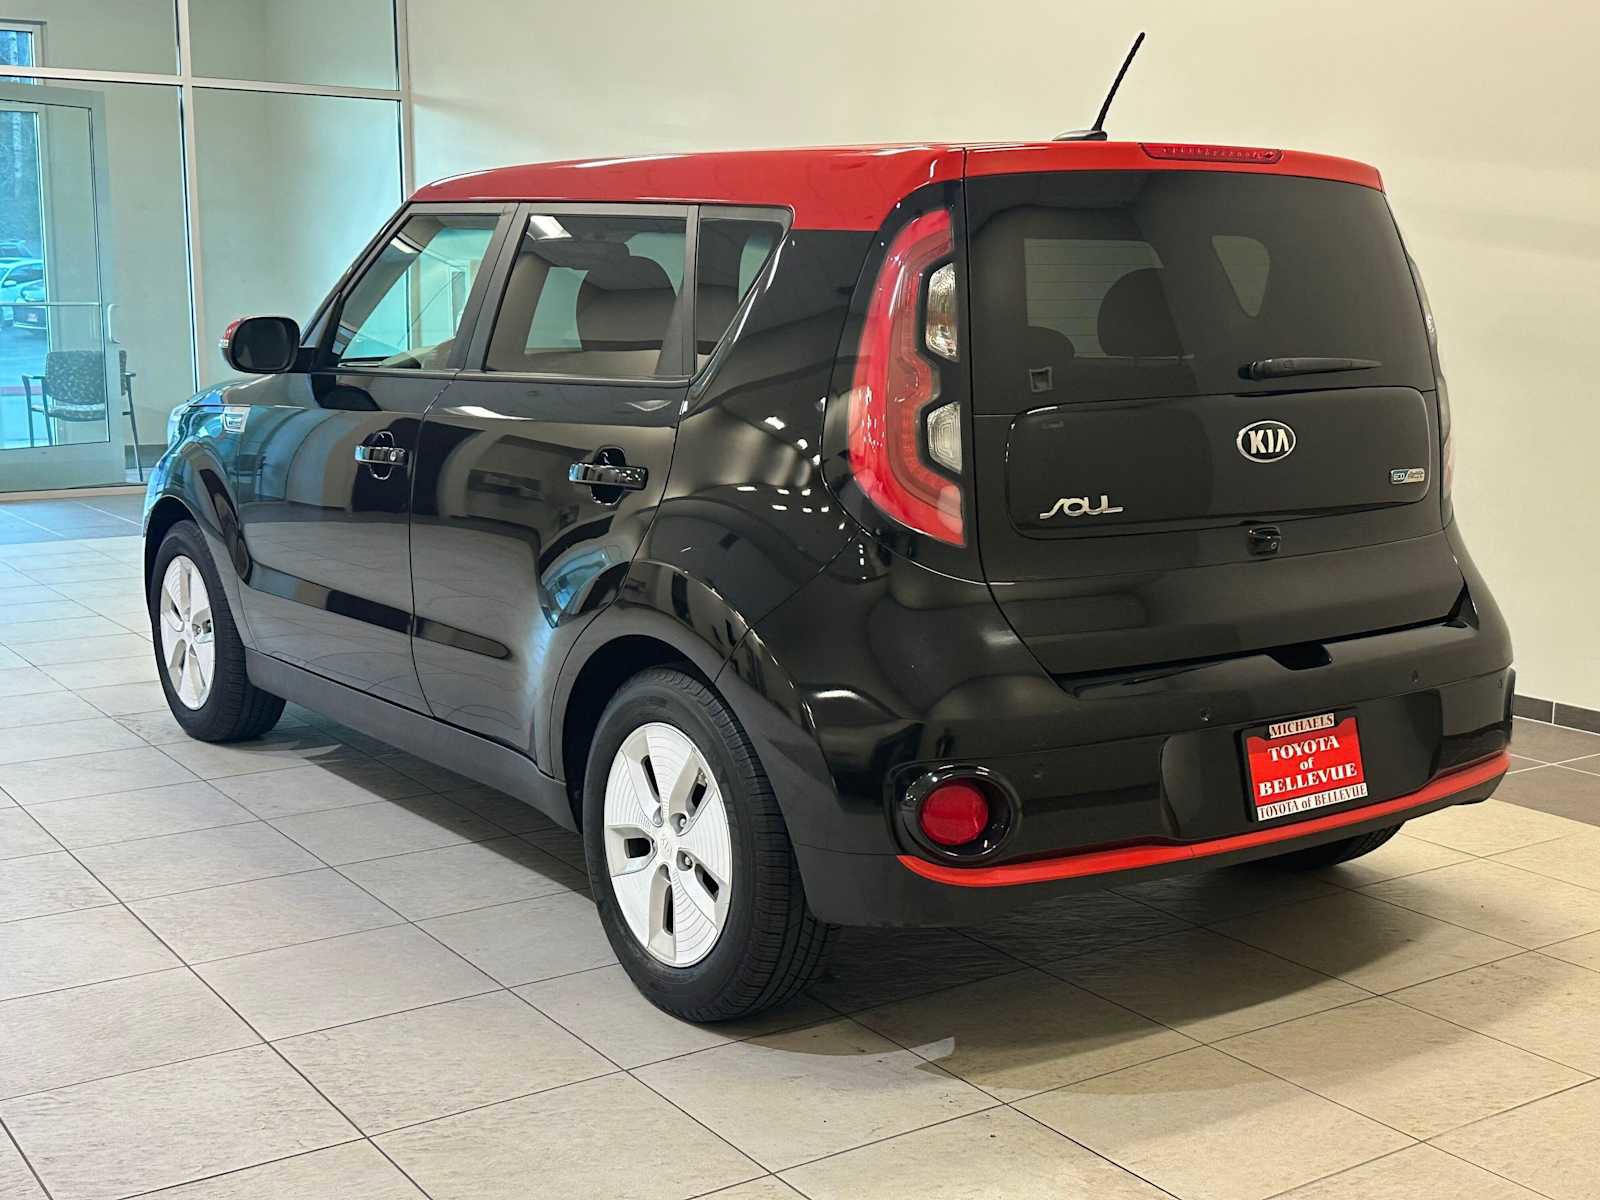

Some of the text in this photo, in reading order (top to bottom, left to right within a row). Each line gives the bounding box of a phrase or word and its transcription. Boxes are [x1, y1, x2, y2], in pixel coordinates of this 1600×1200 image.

[1248, 428, 1289, 454] KIA
[1039, 495, 1123, 519] SOUL
[1270, 714, 1334, 737] MICHAELS
[1267, 735, 1340, 762] TOYOTA
[1299, 757, 1315, 771] of
[1258, 762, 1358, 797] BELLEVUE
[1259, 784, 1367, 819] TOYOTA of BELLEVUE
